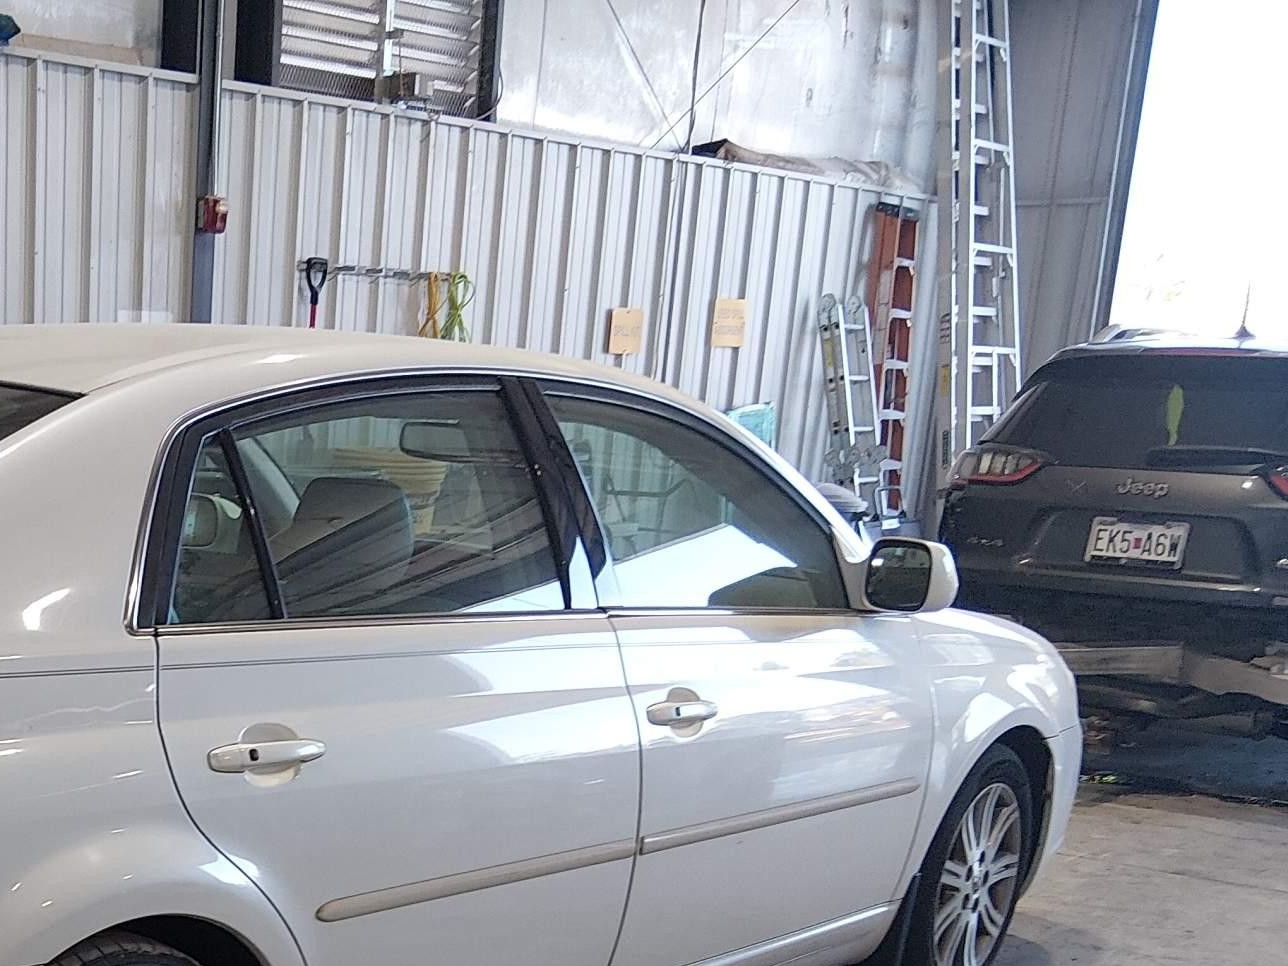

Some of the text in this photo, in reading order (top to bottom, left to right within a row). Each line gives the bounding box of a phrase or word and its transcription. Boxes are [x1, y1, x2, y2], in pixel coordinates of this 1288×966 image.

[1117, 477, 1170, 499] Jeep
[1094, 528, 1183, 558] EK5 A6W
